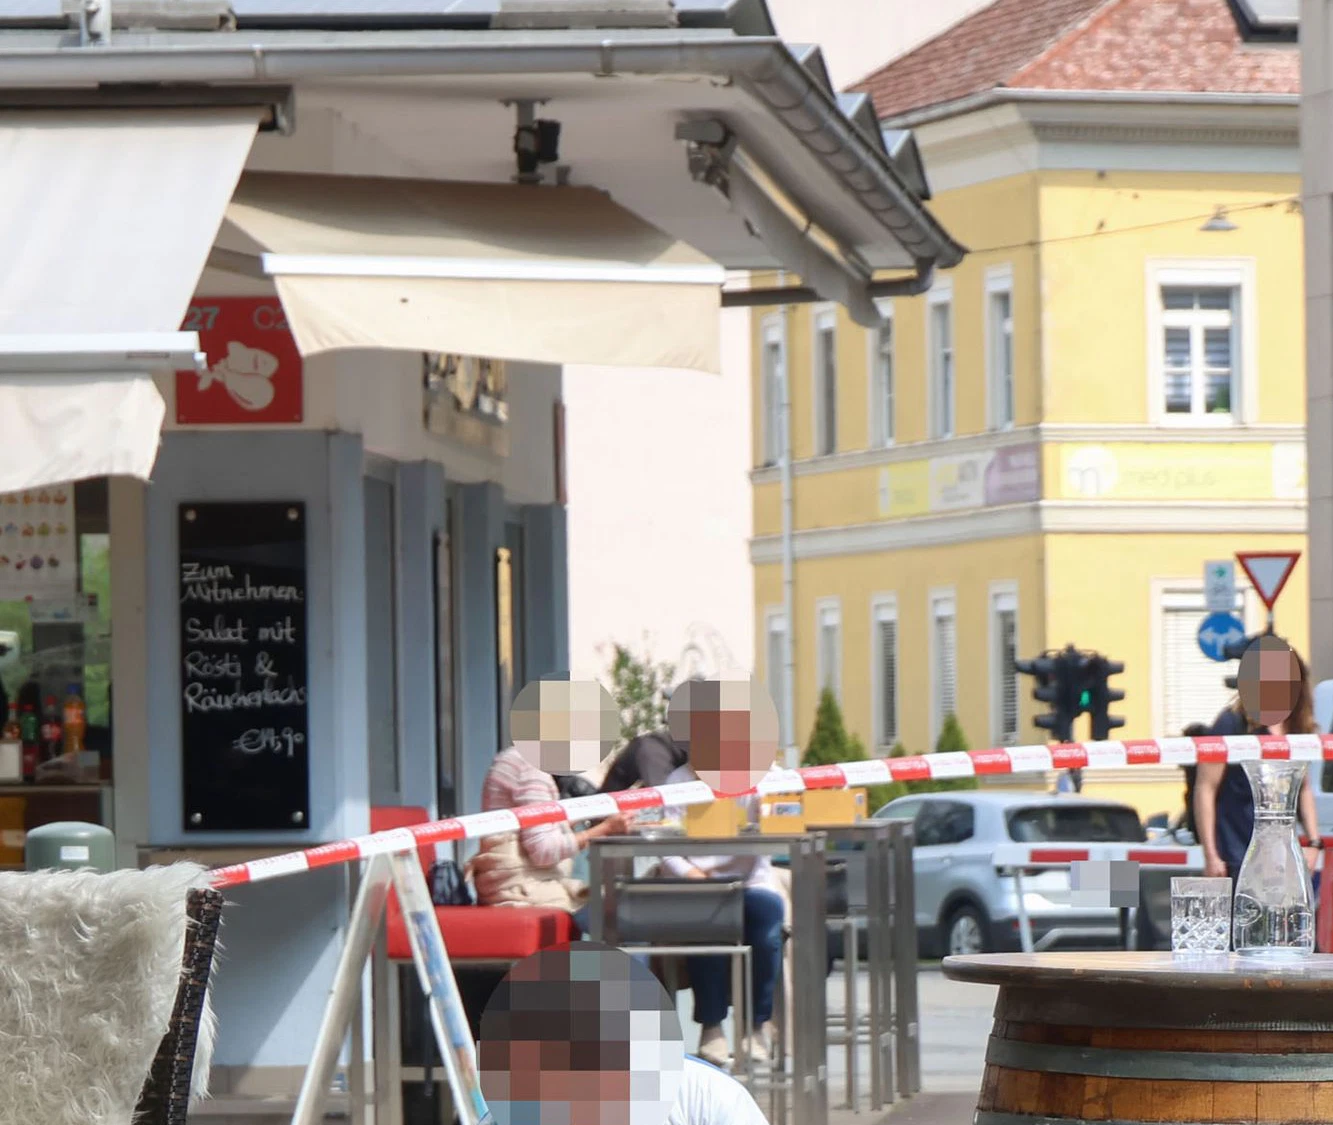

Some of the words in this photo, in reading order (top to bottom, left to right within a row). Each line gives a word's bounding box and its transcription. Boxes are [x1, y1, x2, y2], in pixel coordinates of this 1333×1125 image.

[185, 615, 248, 643] Salat
[258, 616, 295, 643] mit
[185, 651, 242, 677] Rösti
[254, 651, 278, 677] &
